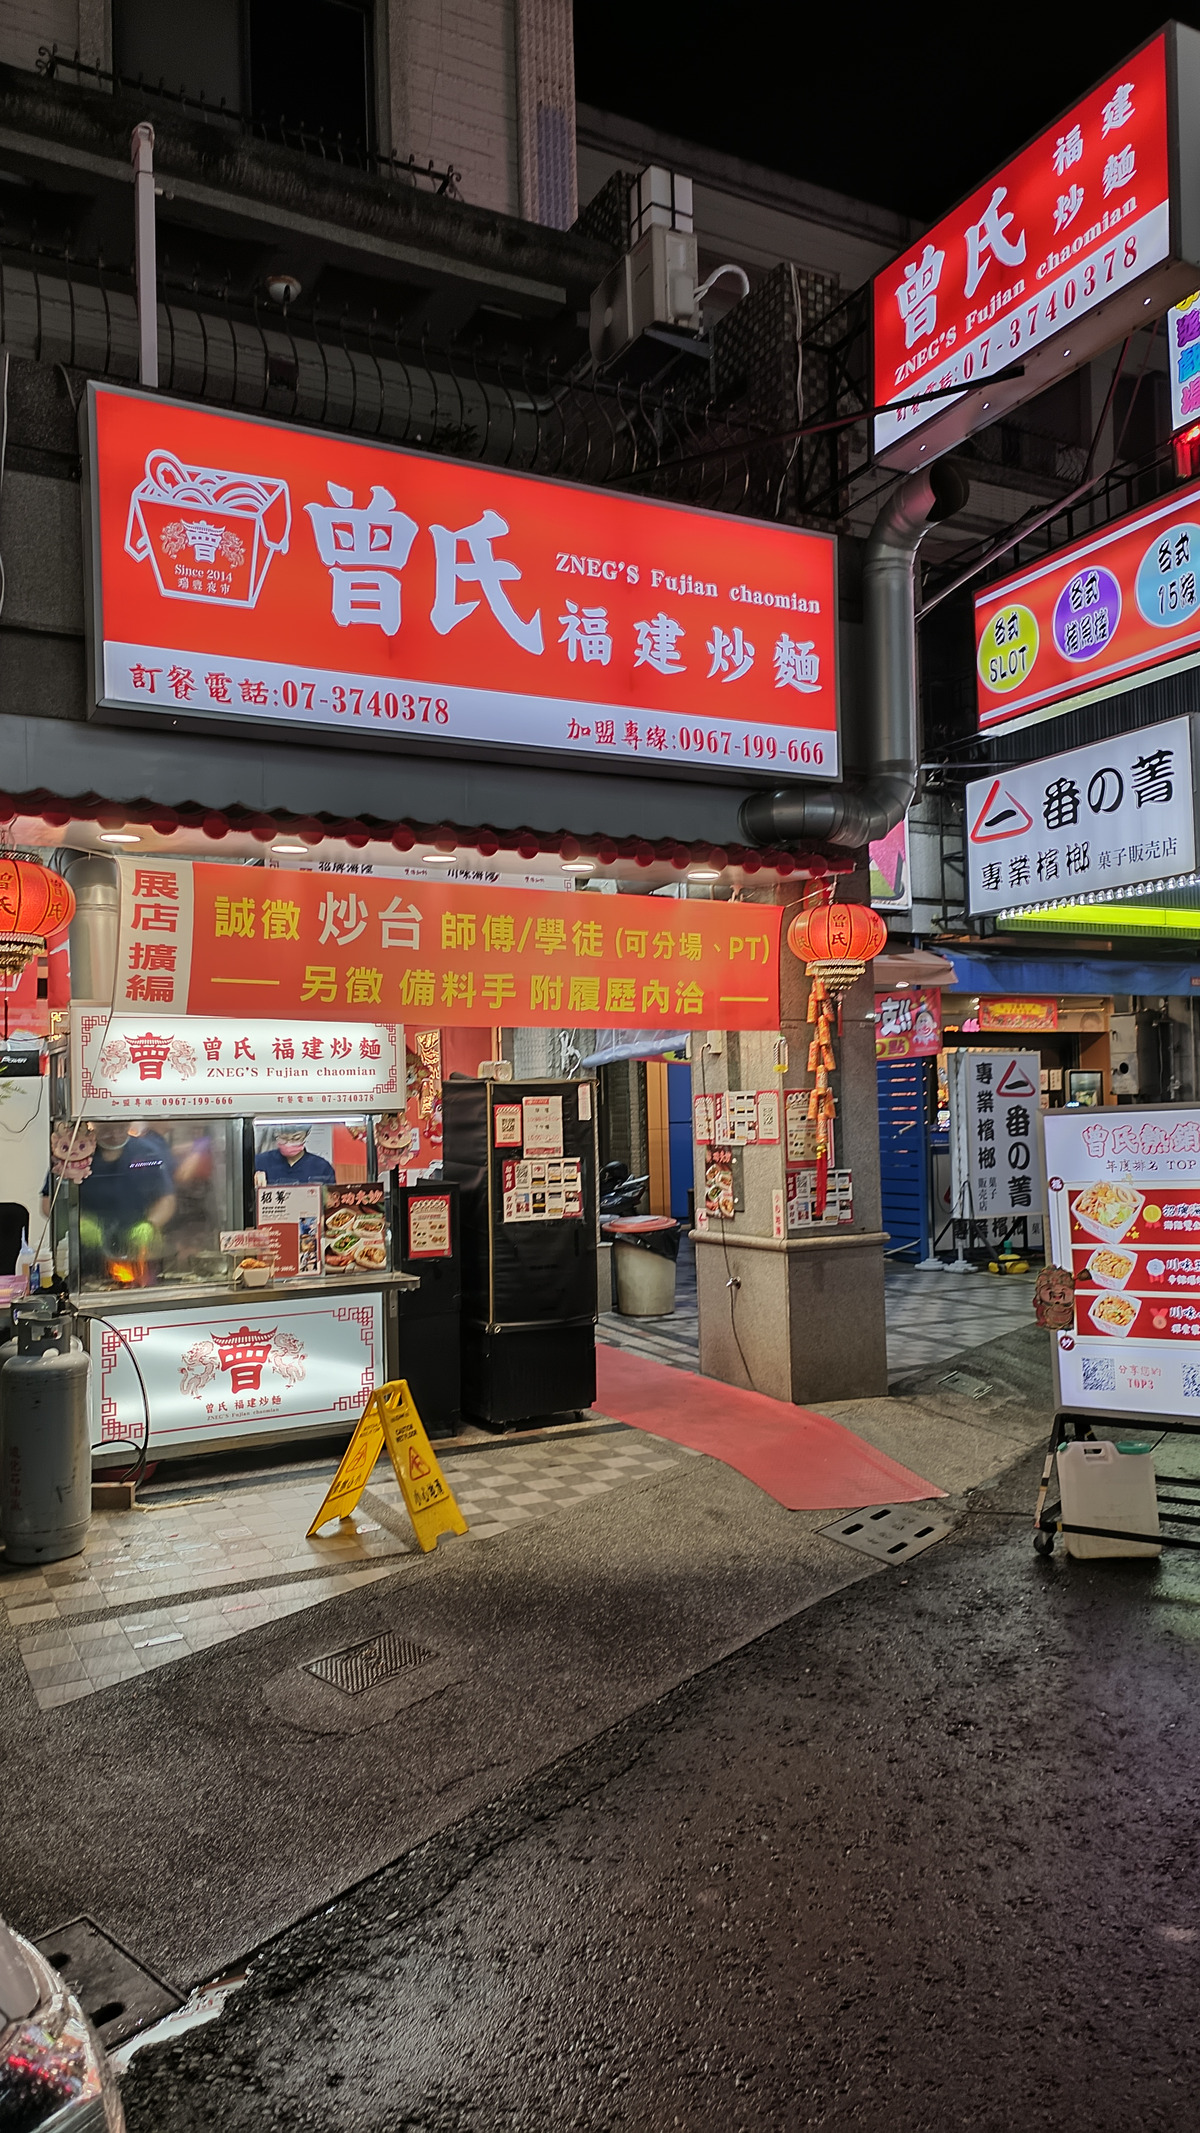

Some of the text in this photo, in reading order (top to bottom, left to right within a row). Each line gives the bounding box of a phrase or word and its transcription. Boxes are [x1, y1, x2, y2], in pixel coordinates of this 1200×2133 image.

[1052, 83, 1136, 177] 福建
[1053, 143, 1137, 236] 炒麵
[894, 186, 1027, 349] 曾氏
[894, 196, 1138, 387] ZNEG'S Fujian chaomian
[174, 564, 233, 583] Since 2014
[302, 480, 546, 656] 曾氏
[1158, 533, 1189, 573] 各式
[555, 552, 821, 615] ZNEG'S Fujian chaomian
[1071, 571, 1099, 612] 各式
[558, 598, 823, 694] 福建炒麵
[994, 612, 1019, 645] 各式
[989, 645, 1027, 683] SLOT
[127, 662, 450, 726] 訂餐電話:07-3740378
[566, 716, 825, 767] 加盟專線:0967-199-666
[981, 841, 1091, 891] 專業檳榔
[126, 869, 179, 1003] 展店擴編
[214, 895, 300, 941] 誠徵
[316, 890, 423, 951] 炒台
[441, 912, 604, 958] 師傅/學徒
[300, 965, 704, 1015] 另徵 備料手 附履歷內洽
[202, 1036, 382, 1062] 曾氏 福建炒麵
[207, 1066, 377, 1079] ZNEG'S Fujian chaomian
[975, 1062, 996, 1170] 專業檳榔
[1106, 1159, 1197, 1173] 年度排名 TOP
[1119, 1365, 1162, 1376] 分享您的
[1127, 1378, 1154, 1389] TOP3
[205, 1395, 282, 1413] 曾氏 福建炒麵
